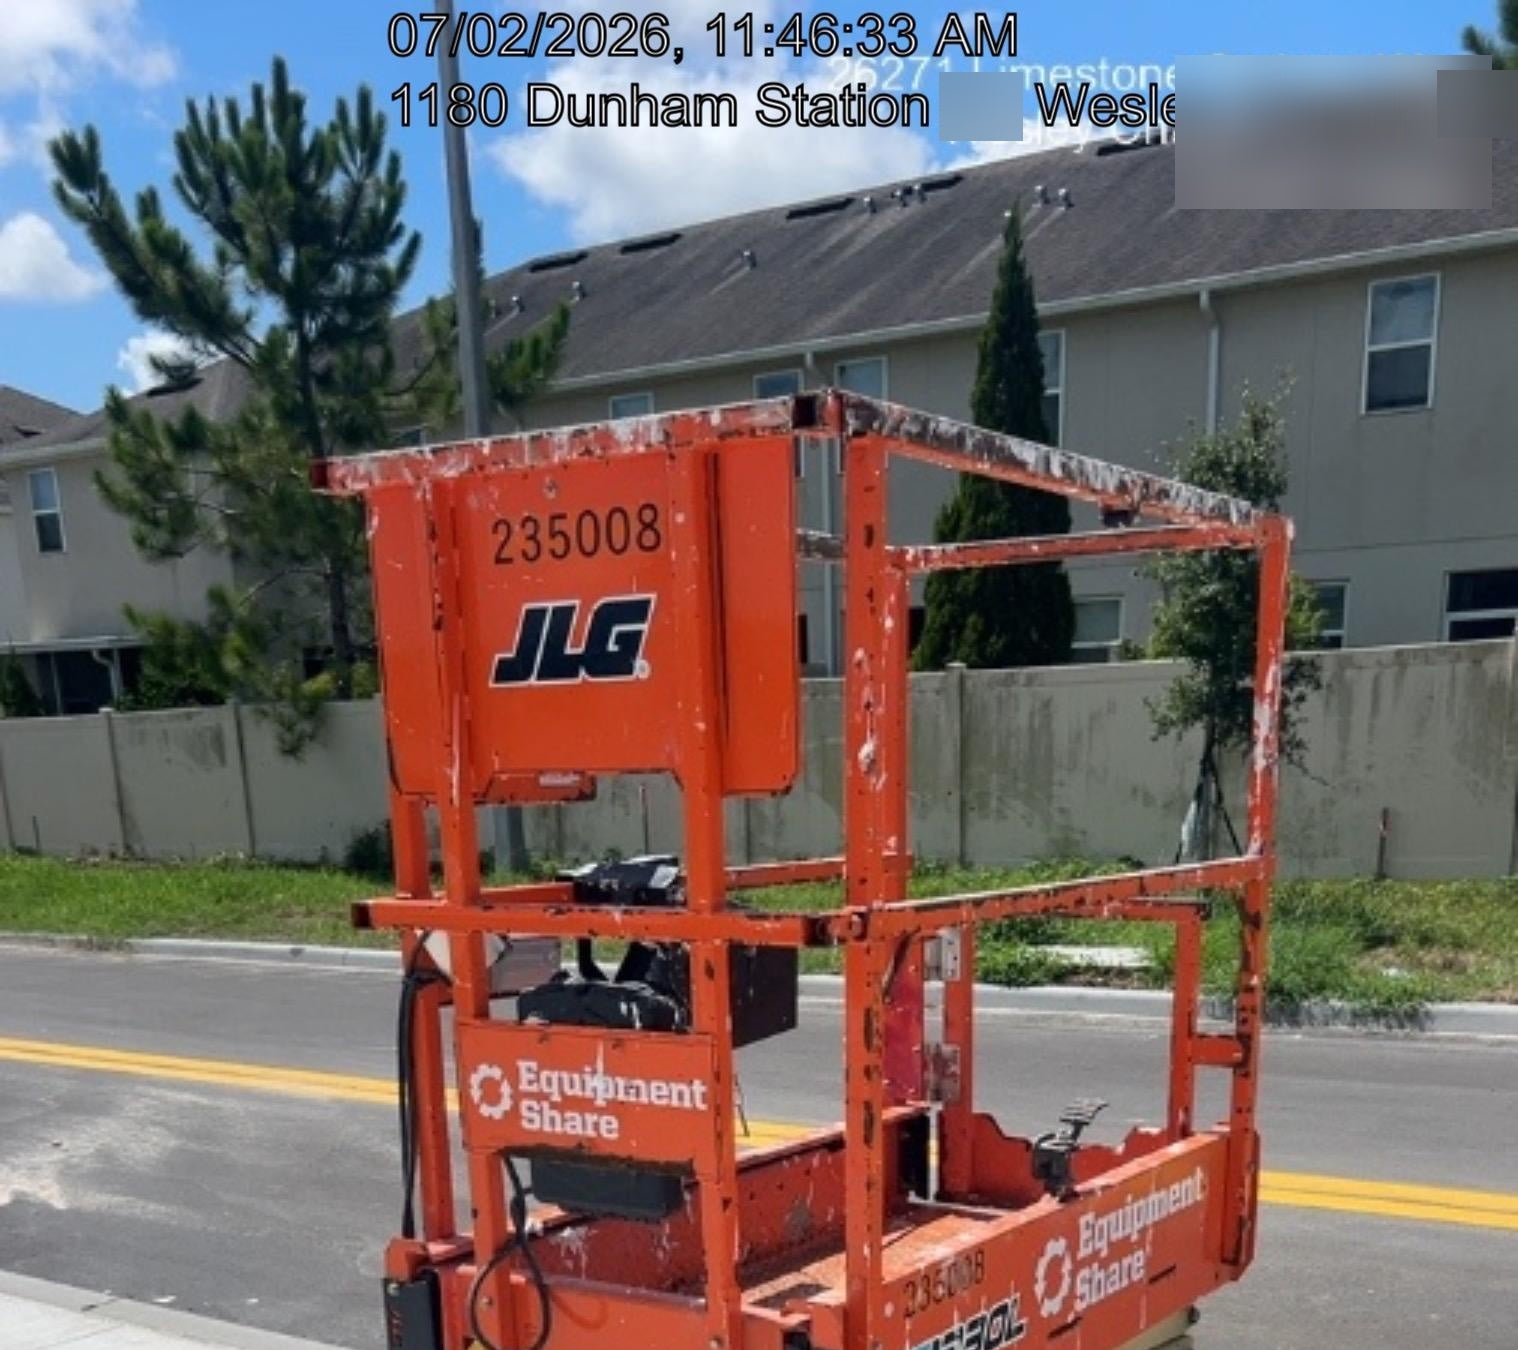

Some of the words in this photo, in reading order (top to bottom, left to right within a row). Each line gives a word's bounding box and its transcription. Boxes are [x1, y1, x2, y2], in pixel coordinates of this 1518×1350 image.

[491, 502, 662, 565] 235008
[488, 592, 657, 688] JLG
[516, 1059, 708, 1111] Equipment
[520, 1100, 619, 1140] Share
[1077, 1167, 1206, 1260] Equipment
[1073, 1249, 1146, 1312] Share
